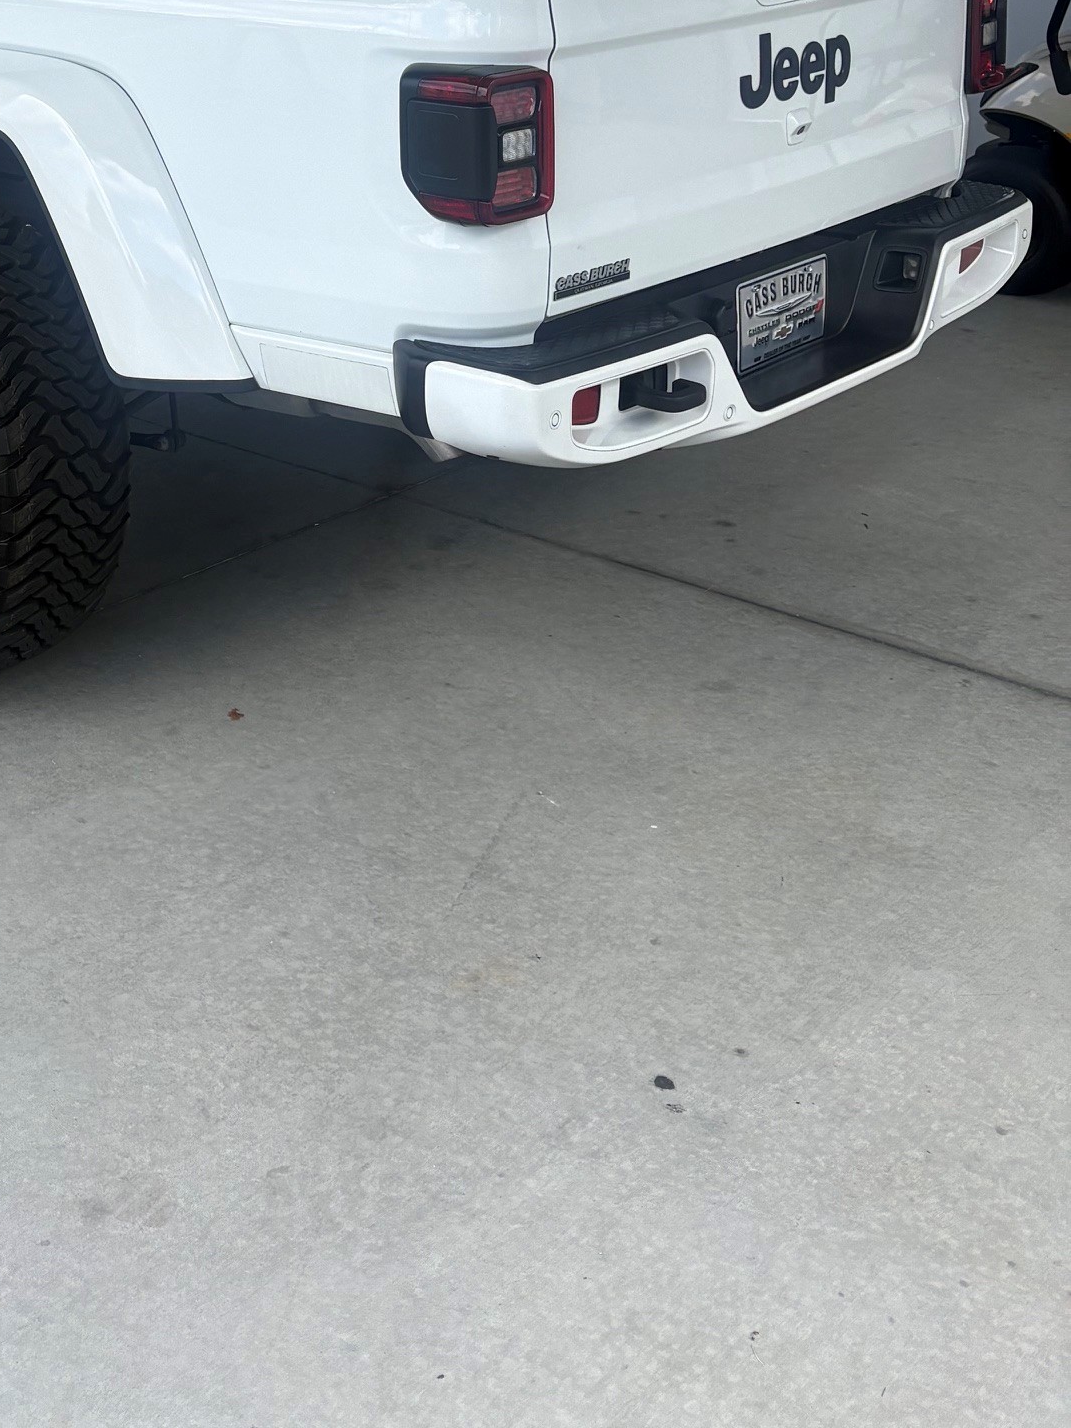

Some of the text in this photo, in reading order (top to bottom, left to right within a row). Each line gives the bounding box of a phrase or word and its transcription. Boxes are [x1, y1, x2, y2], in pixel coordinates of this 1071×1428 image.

[740, 33, 851, 109] Jeep
[555, 258, 630, 291] CASS BURCH
[746, 272, 822, 319] CASS BURCH
[753, 334, 769, 348] Jeep
